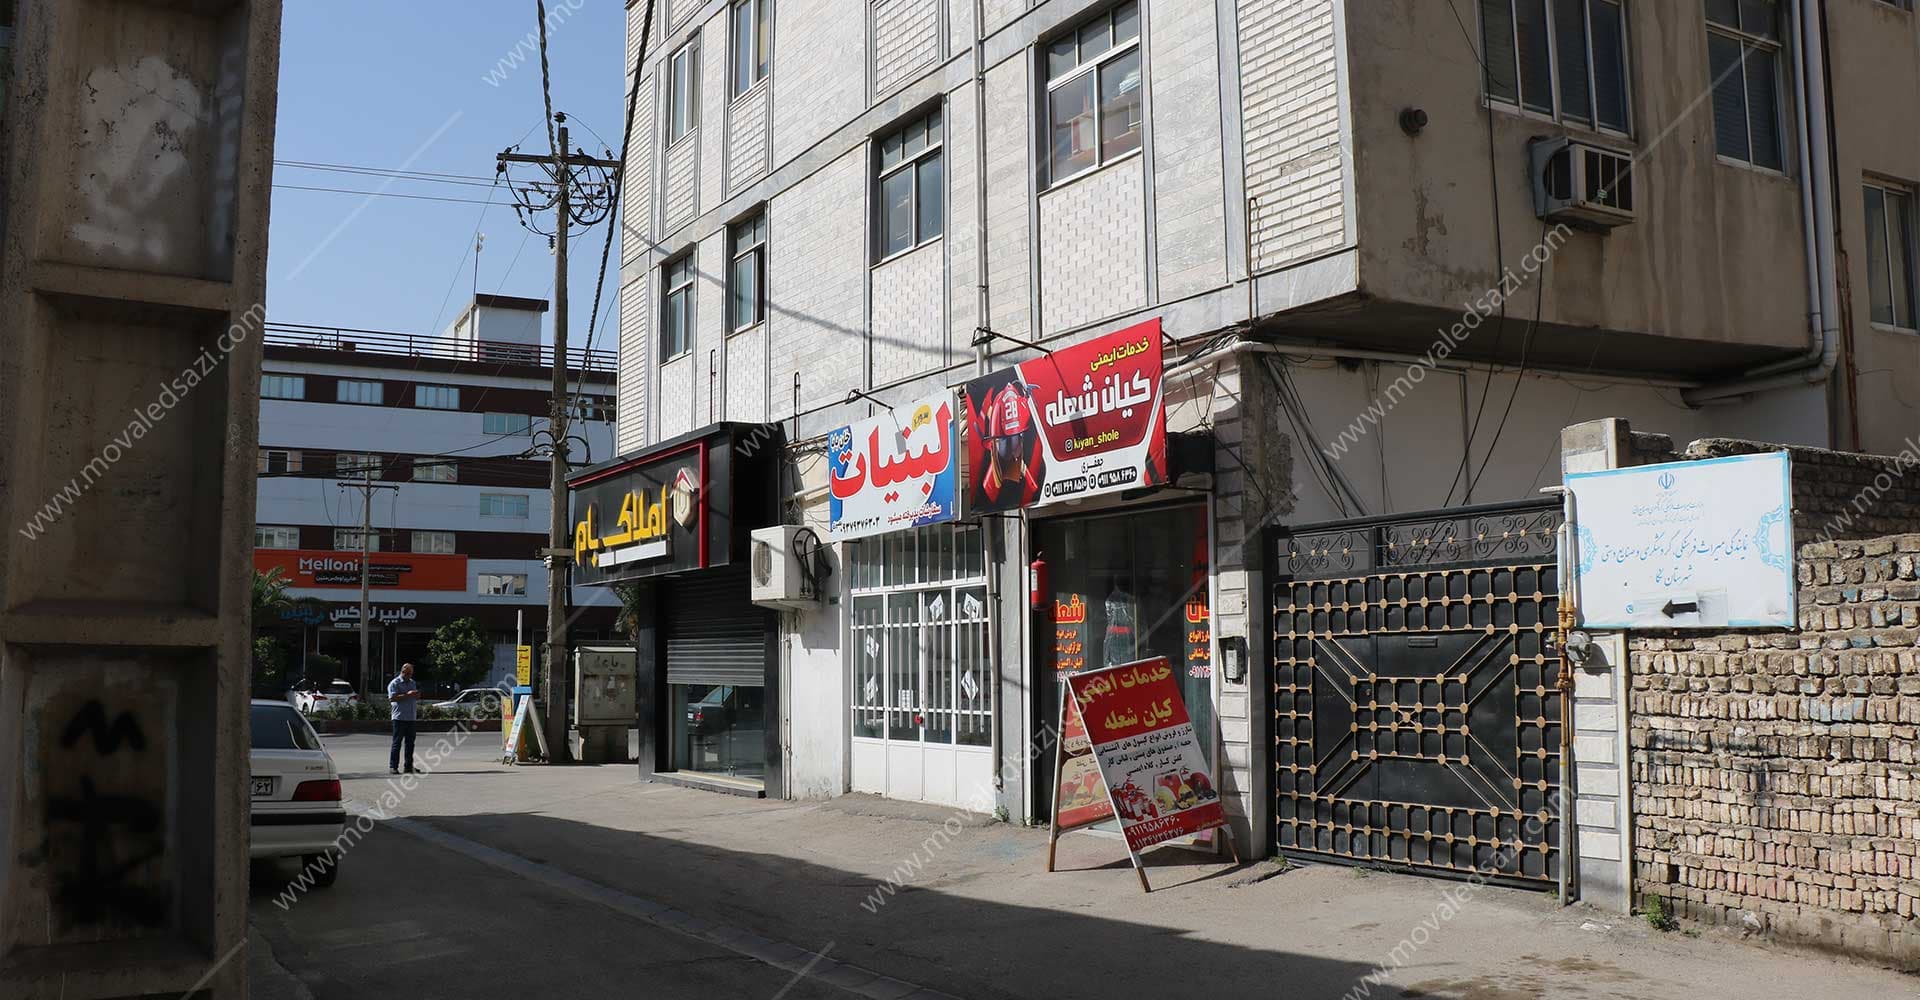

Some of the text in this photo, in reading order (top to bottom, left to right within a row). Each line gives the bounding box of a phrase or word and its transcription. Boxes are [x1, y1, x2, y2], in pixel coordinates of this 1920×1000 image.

[1090, 336, 1151, 372] خدمات ایمنی
[1045, 369, 1151, 427] کیان شعله
[831, 400, 952, 504] لبنیات
[576, 481, 667, 568] املاک بام
[299, 558, 358, 571] Melloni
[379, 606, 417, 626] هایپر
[1078, 672, 1118, 704] ایمنی
[1120, 661, 1171, 688] خدمات
[1104, 707, 1138, 730] شعله
[1142, 697, 1173, 728] کیان
